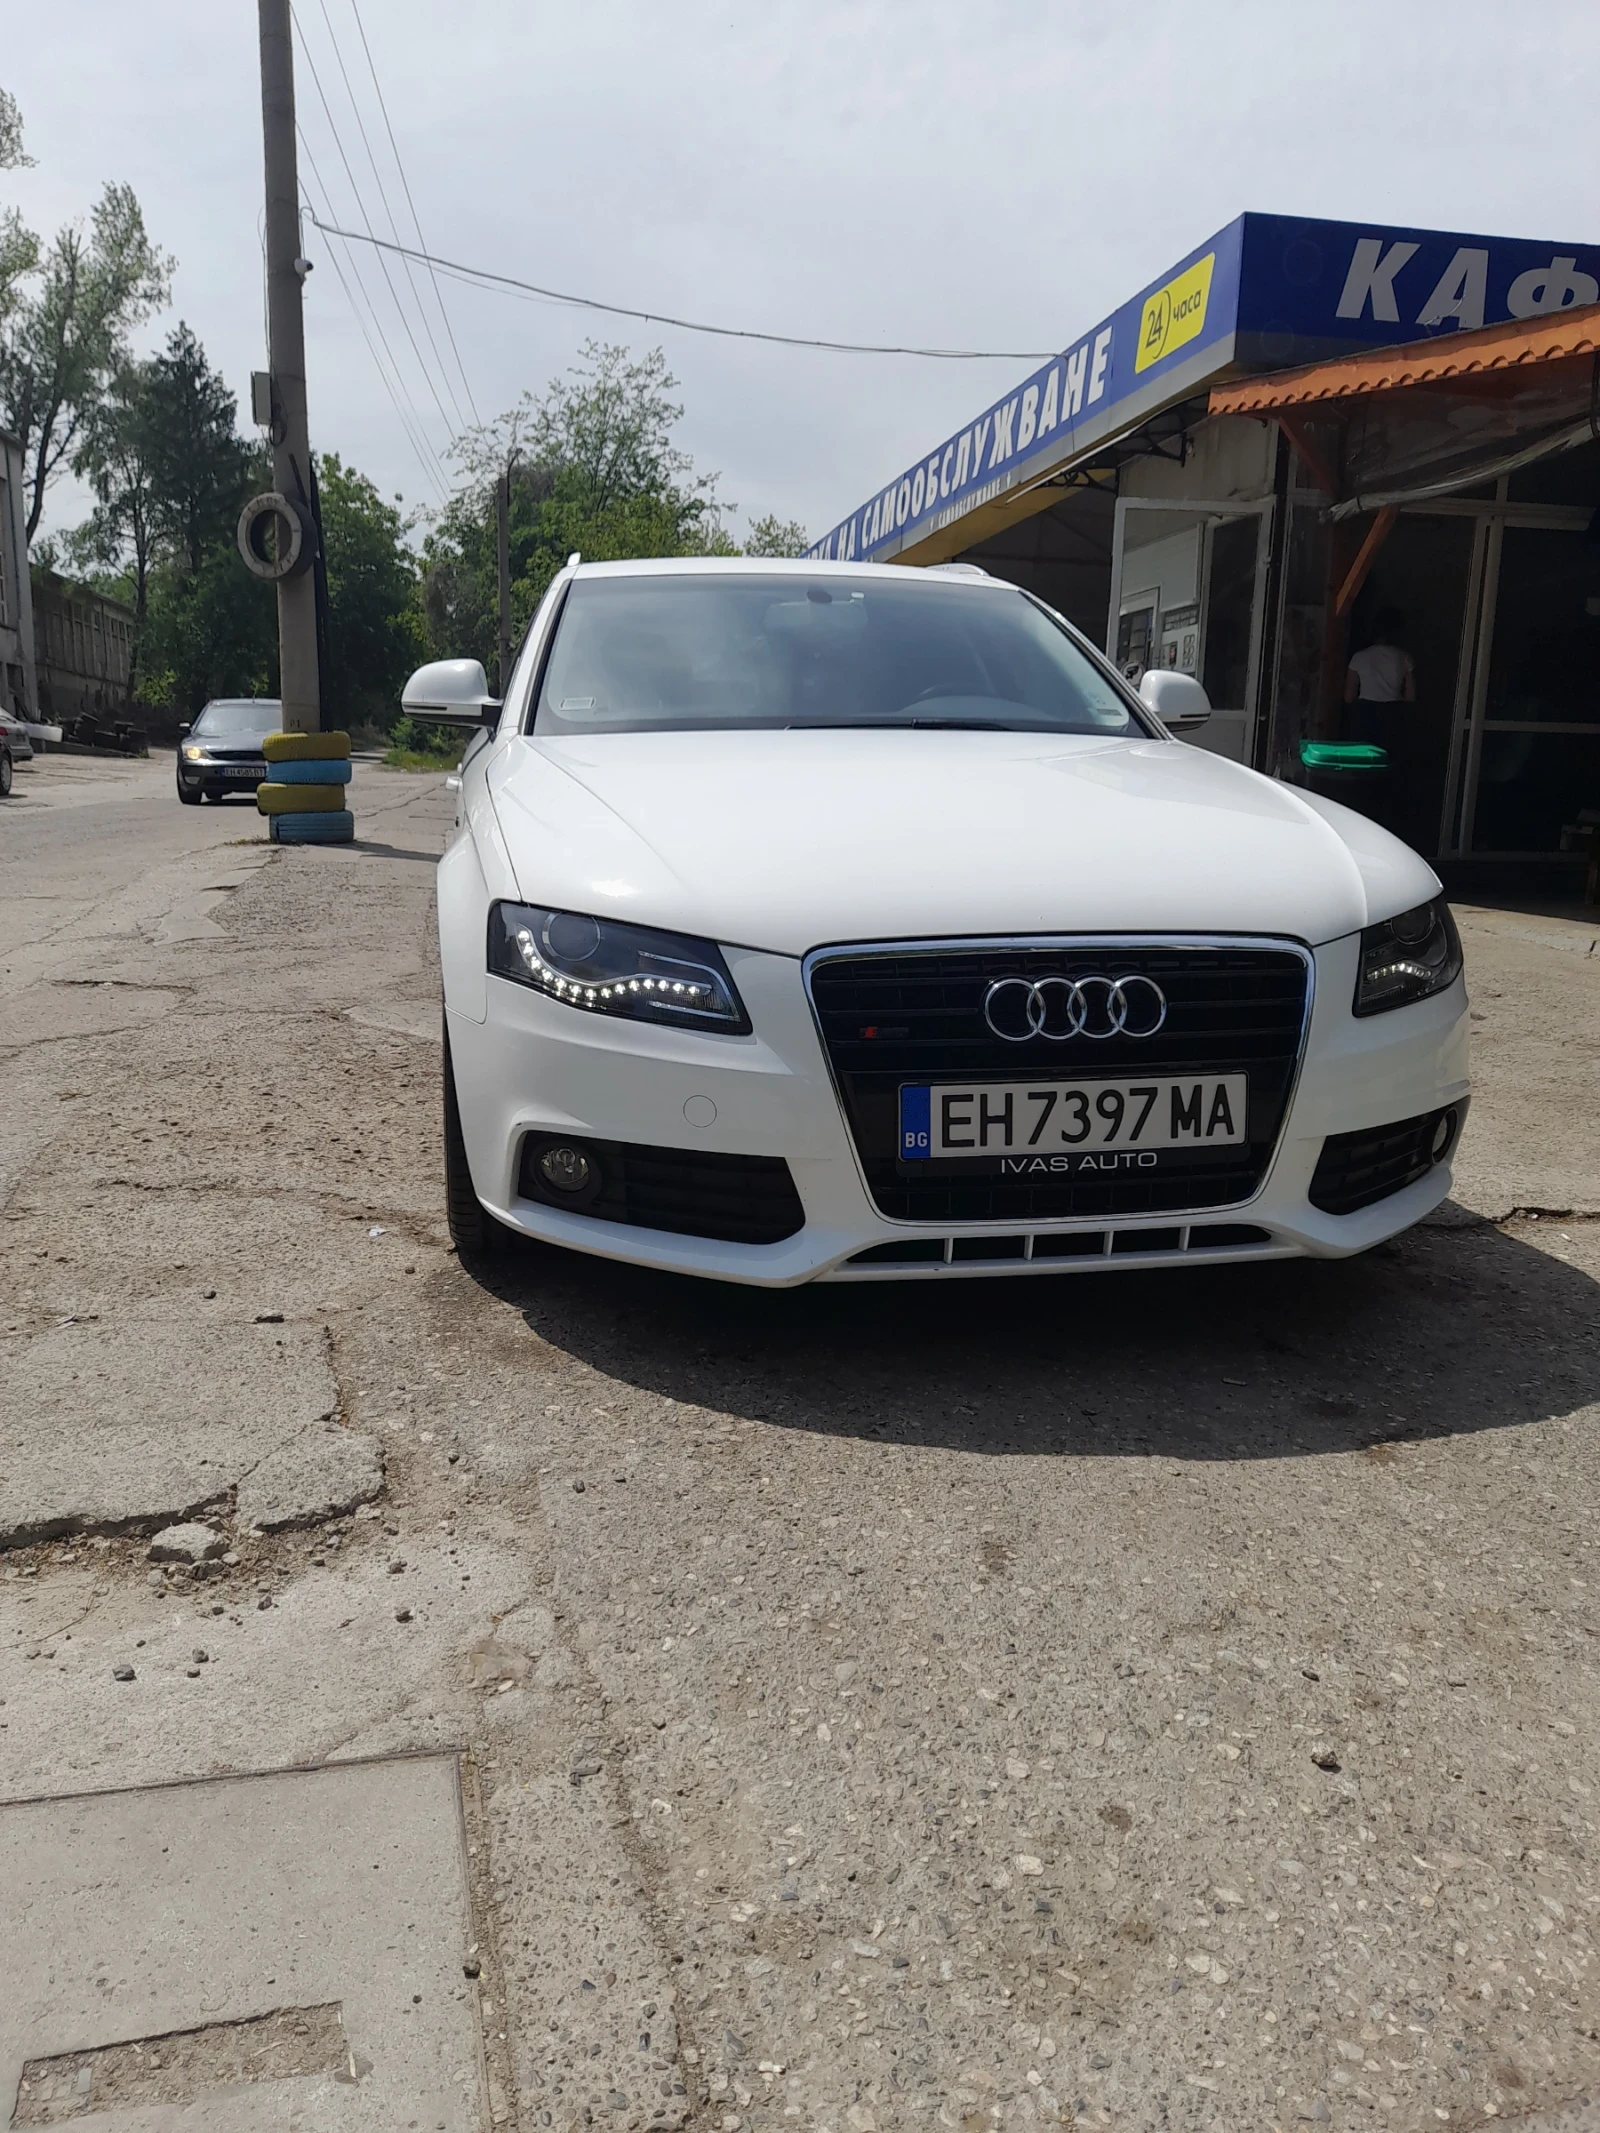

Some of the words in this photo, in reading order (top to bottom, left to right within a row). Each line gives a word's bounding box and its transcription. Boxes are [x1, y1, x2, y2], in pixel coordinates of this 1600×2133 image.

[1335, 238, 1599, 329] КАФ
[1145, 301, 1163, 349] 24
[1173, 289, 1202, 322] часа
[861, 326, 1112, 549] САМООБСЛУЖВАНЕ
[905, 1132, 928, 1148] BG
[941, 1093, 1013, 1148] EH
[1027, 1087, 1159, 1145] 7397
[1170, 1084, 1235, 1139] MA
[1001, 1157, 1069, 1174] IVAS
[1078, 1152, 1158, 1170] AUTO
